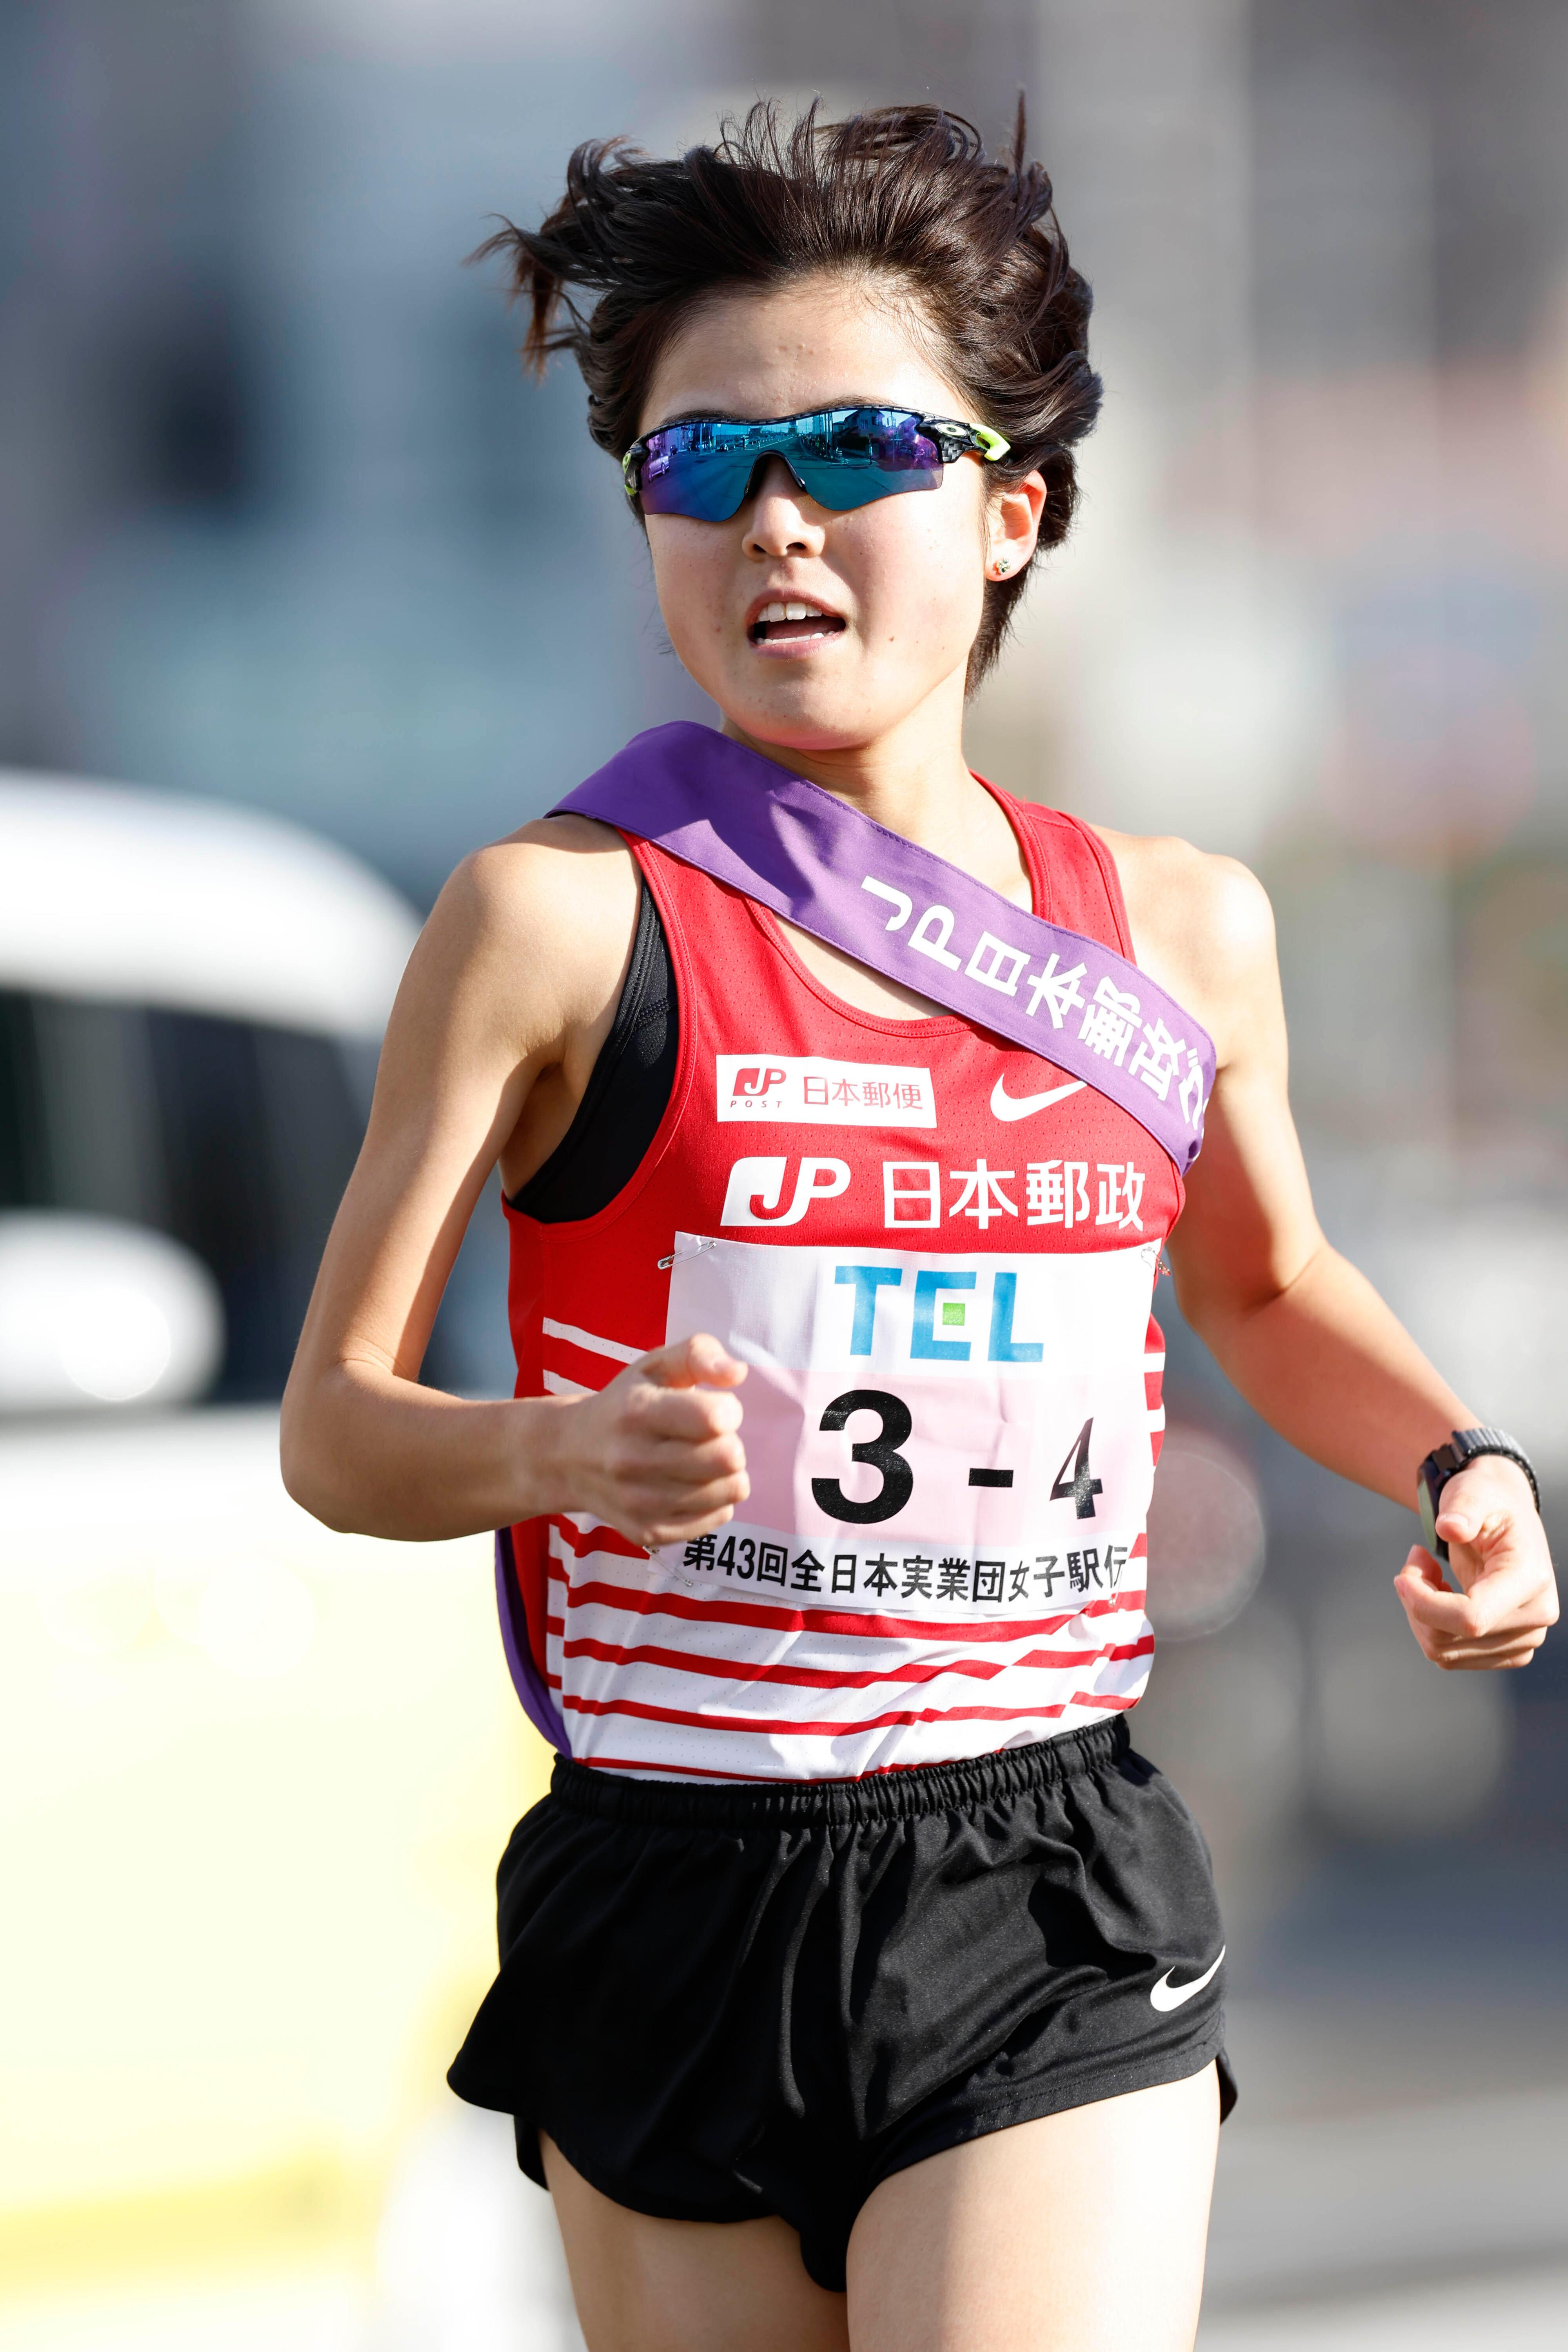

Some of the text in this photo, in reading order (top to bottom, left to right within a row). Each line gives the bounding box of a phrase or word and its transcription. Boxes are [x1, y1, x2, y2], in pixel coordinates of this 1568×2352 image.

[860, 875, 1209, 1138] JP日本郵政グ
[730, 1100, 782, 1108] POST
[732, 1068, 923, 1110] JP 日本郵便
[720, 1156, 1146, 1232] JP 日本郵政
[834, 1265, 1044, 1363] TEL
